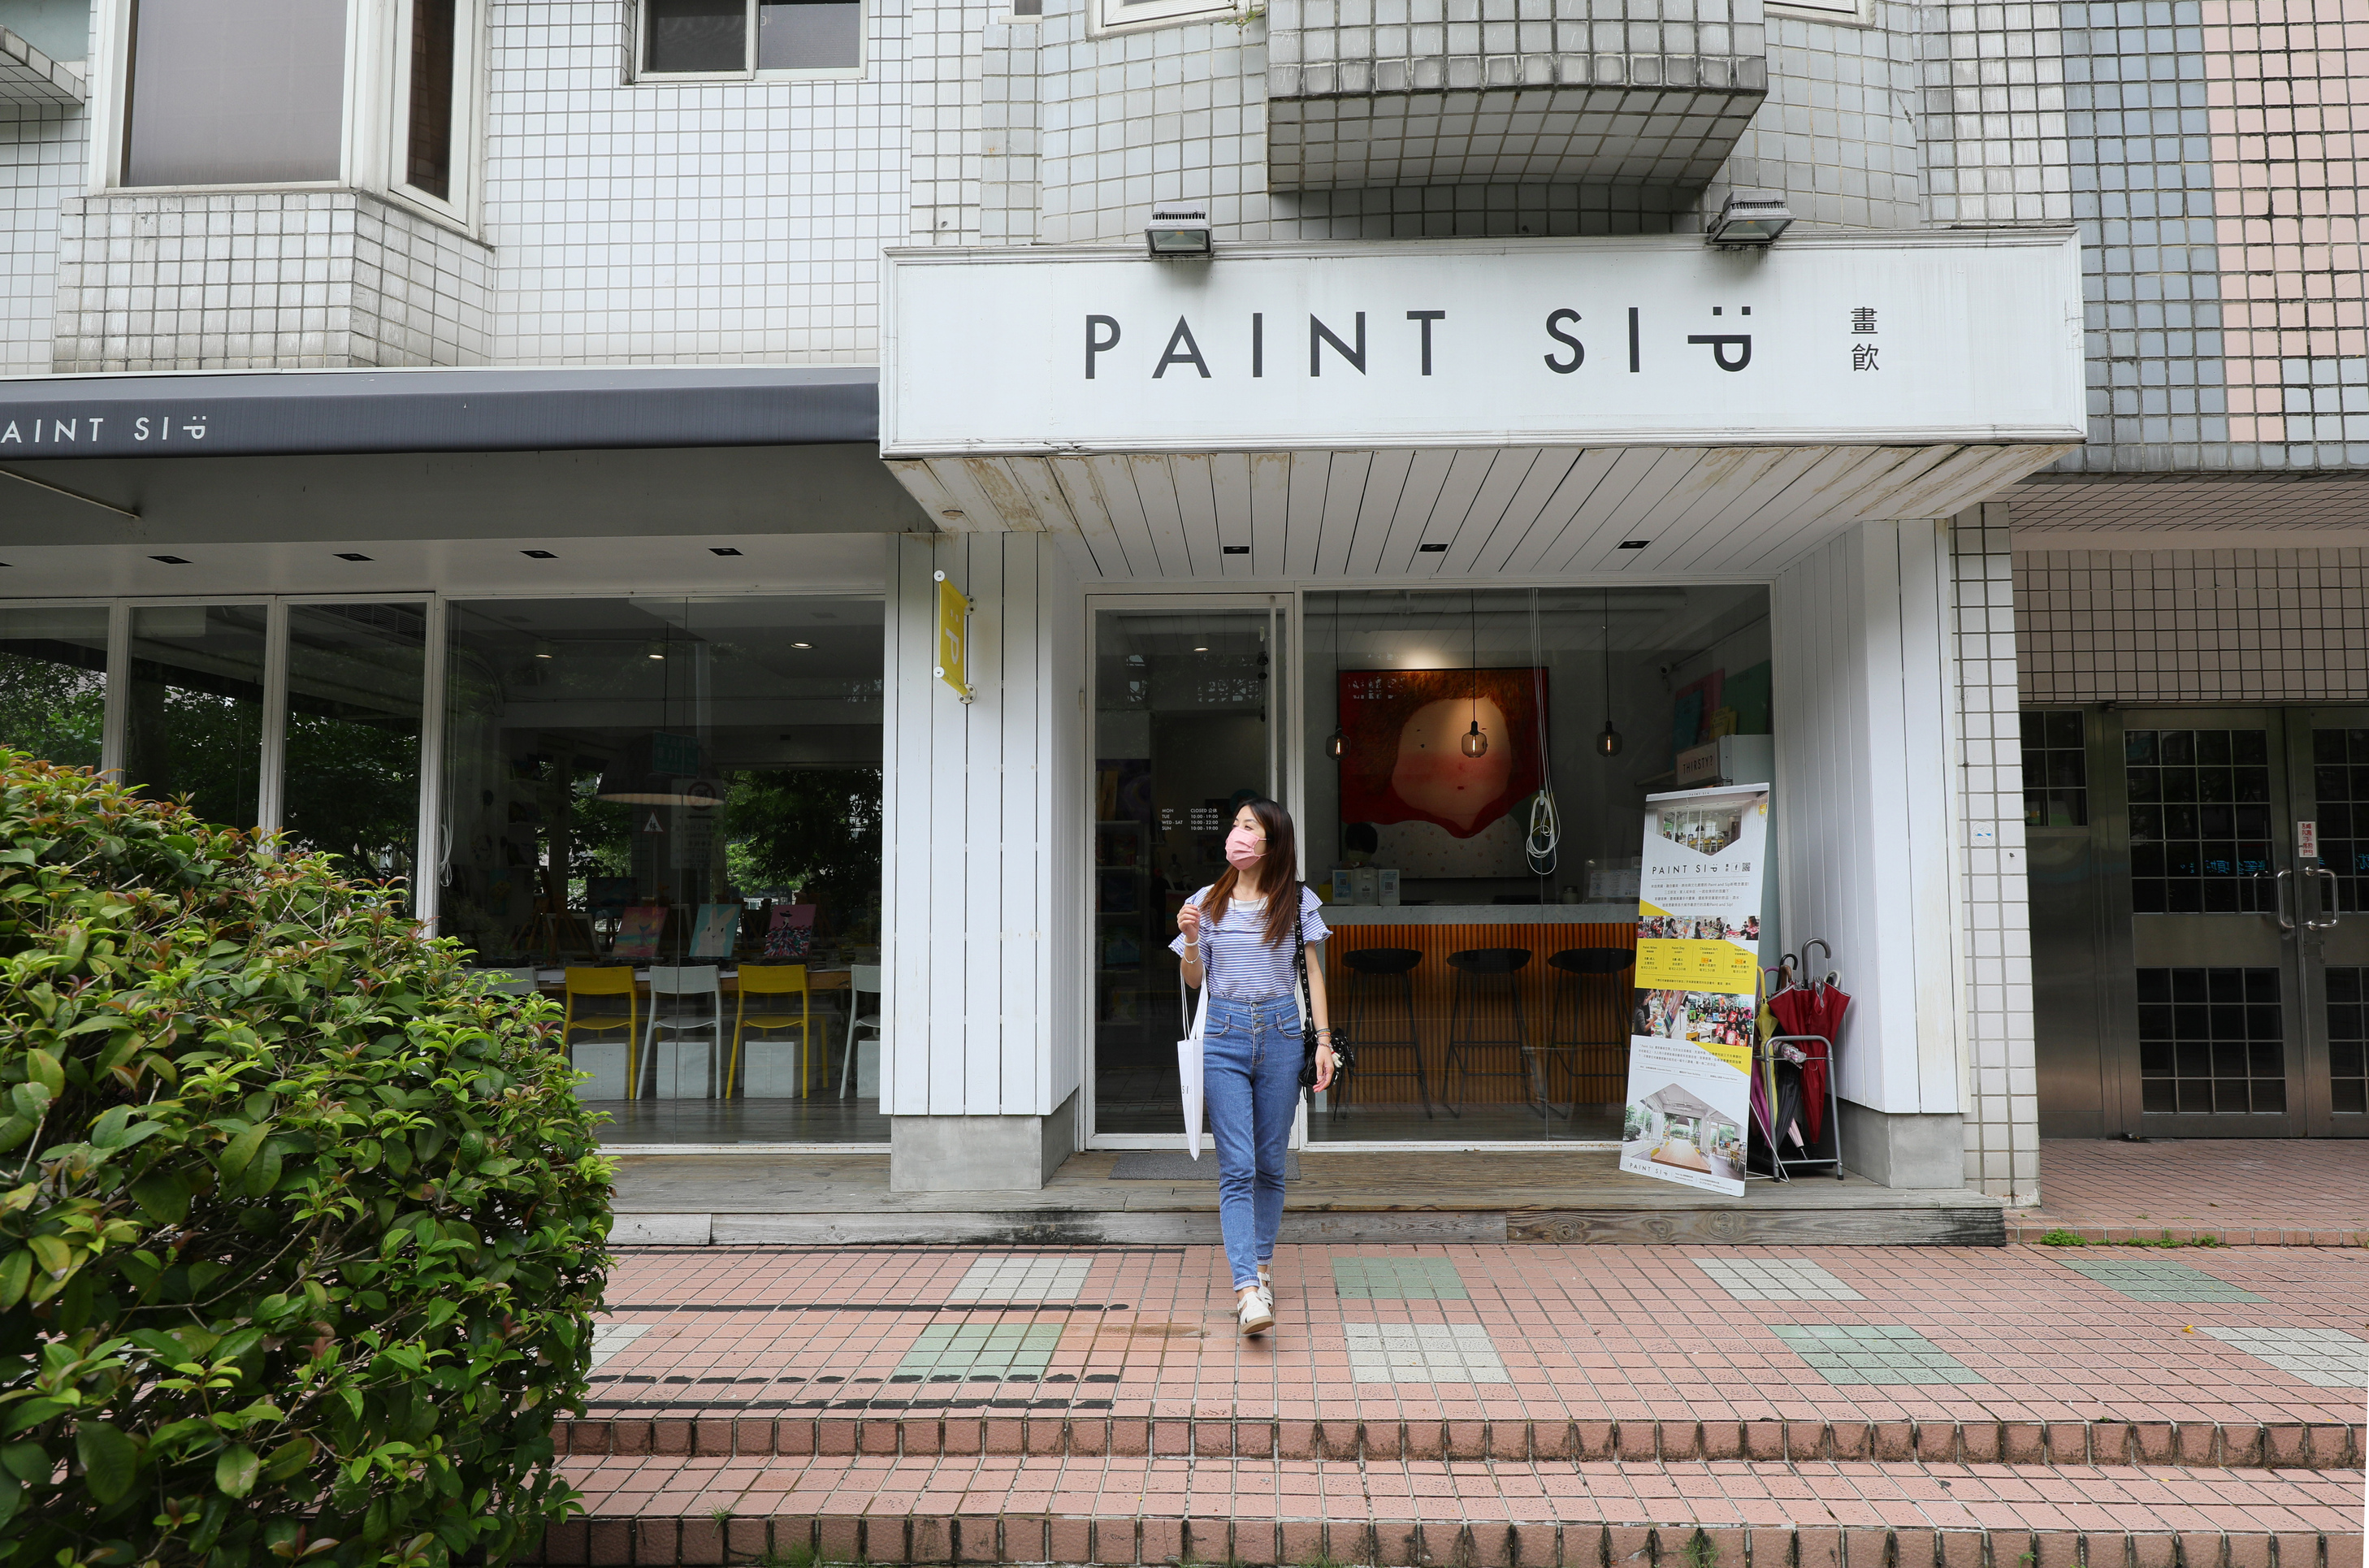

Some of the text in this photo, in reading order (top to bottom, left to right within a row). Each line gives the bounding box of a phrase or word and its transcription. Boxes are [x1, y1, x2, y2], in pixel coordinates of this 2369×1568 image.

[1085, 305, 1752, 379] PAINT SIP
[1850, 305, 1880, 372] 畫飲
[0, 415, 206, 444] AINT SIP
[1683, 755, 1713, 774] THIRSTY?
[2302, 822, 2314, 856] 請隨手關門
[1652, 864, 1687, 875] PAINT
[1630, 1162, 1651, 1172] PAINT
